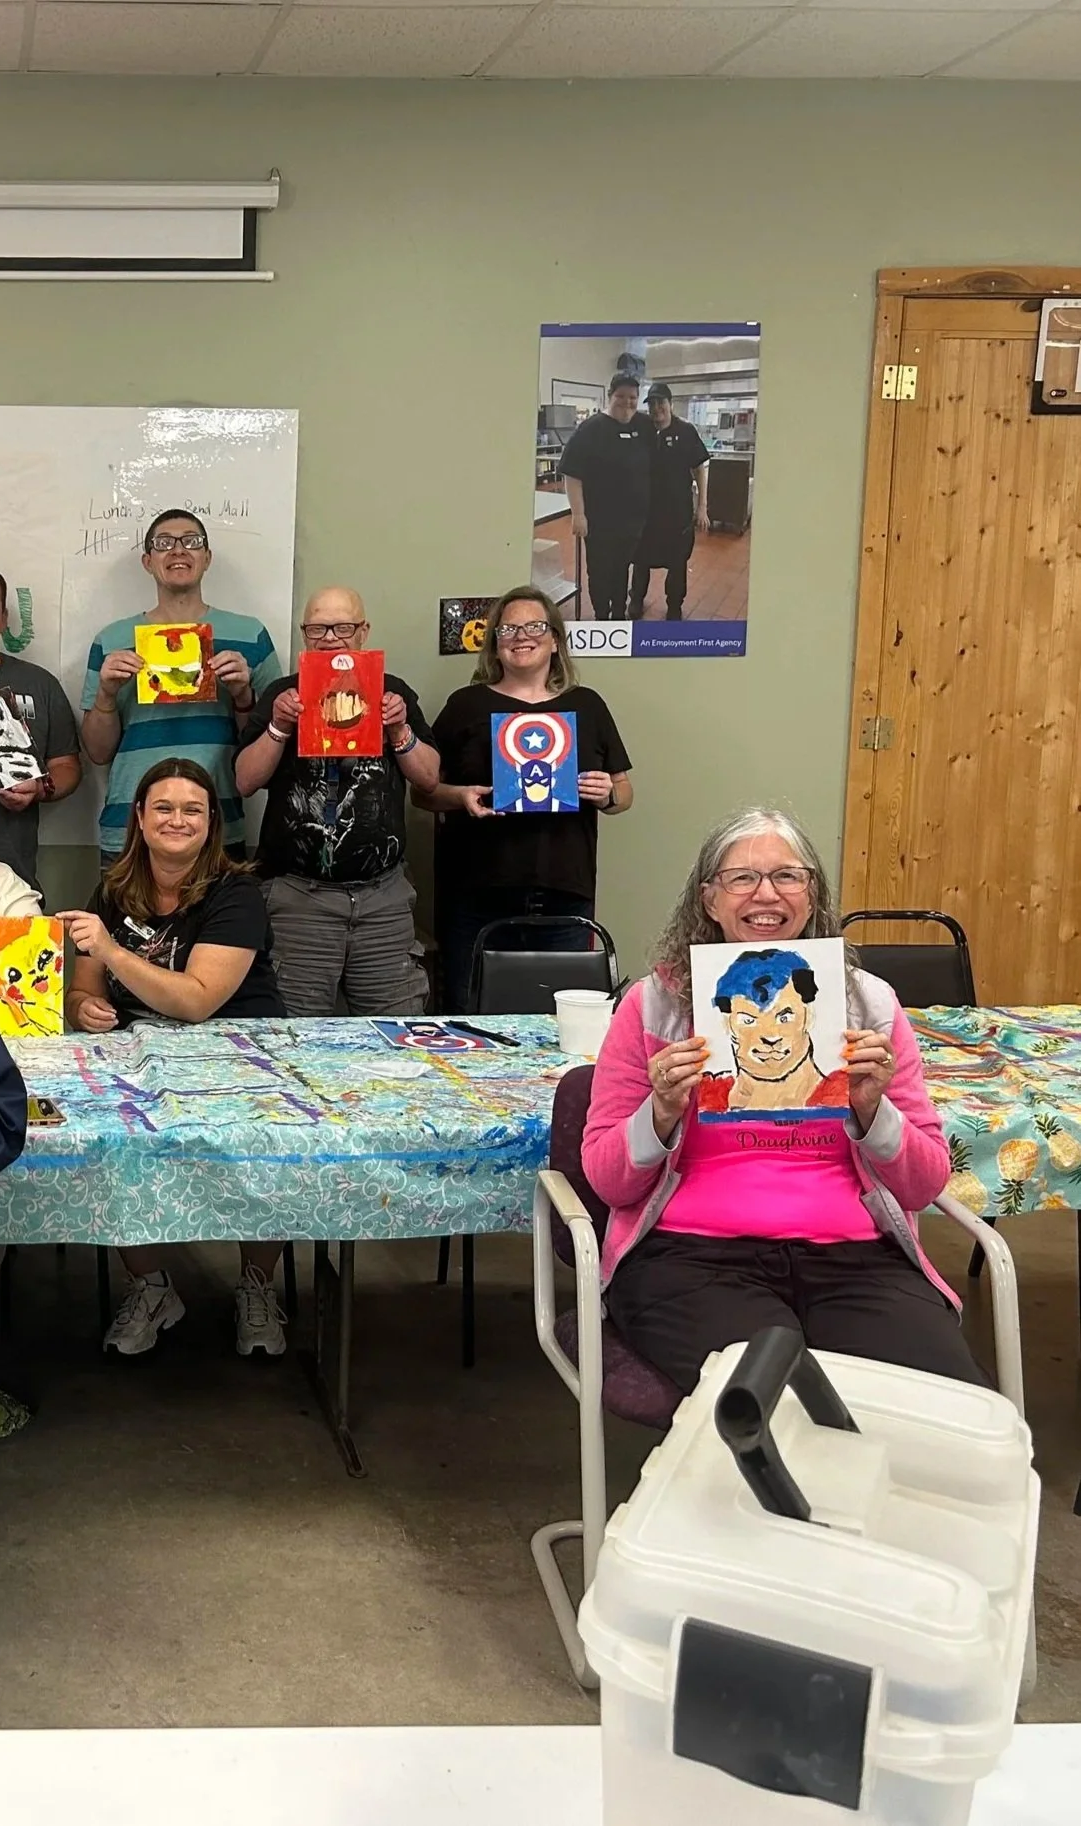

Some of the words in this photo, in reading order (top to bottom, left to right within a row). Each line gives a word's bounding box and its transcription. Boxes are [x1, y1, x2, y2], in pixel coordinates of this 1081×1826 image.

[219, 498, 249, 517] Mall
[640, 639, 651, 647] An
[652, 639, 697, 648] Employment
[699, 639, 714, 647] First
[715, 639, 742, 648] Agency
[736, 1128, 836, 1152] Doughvine
